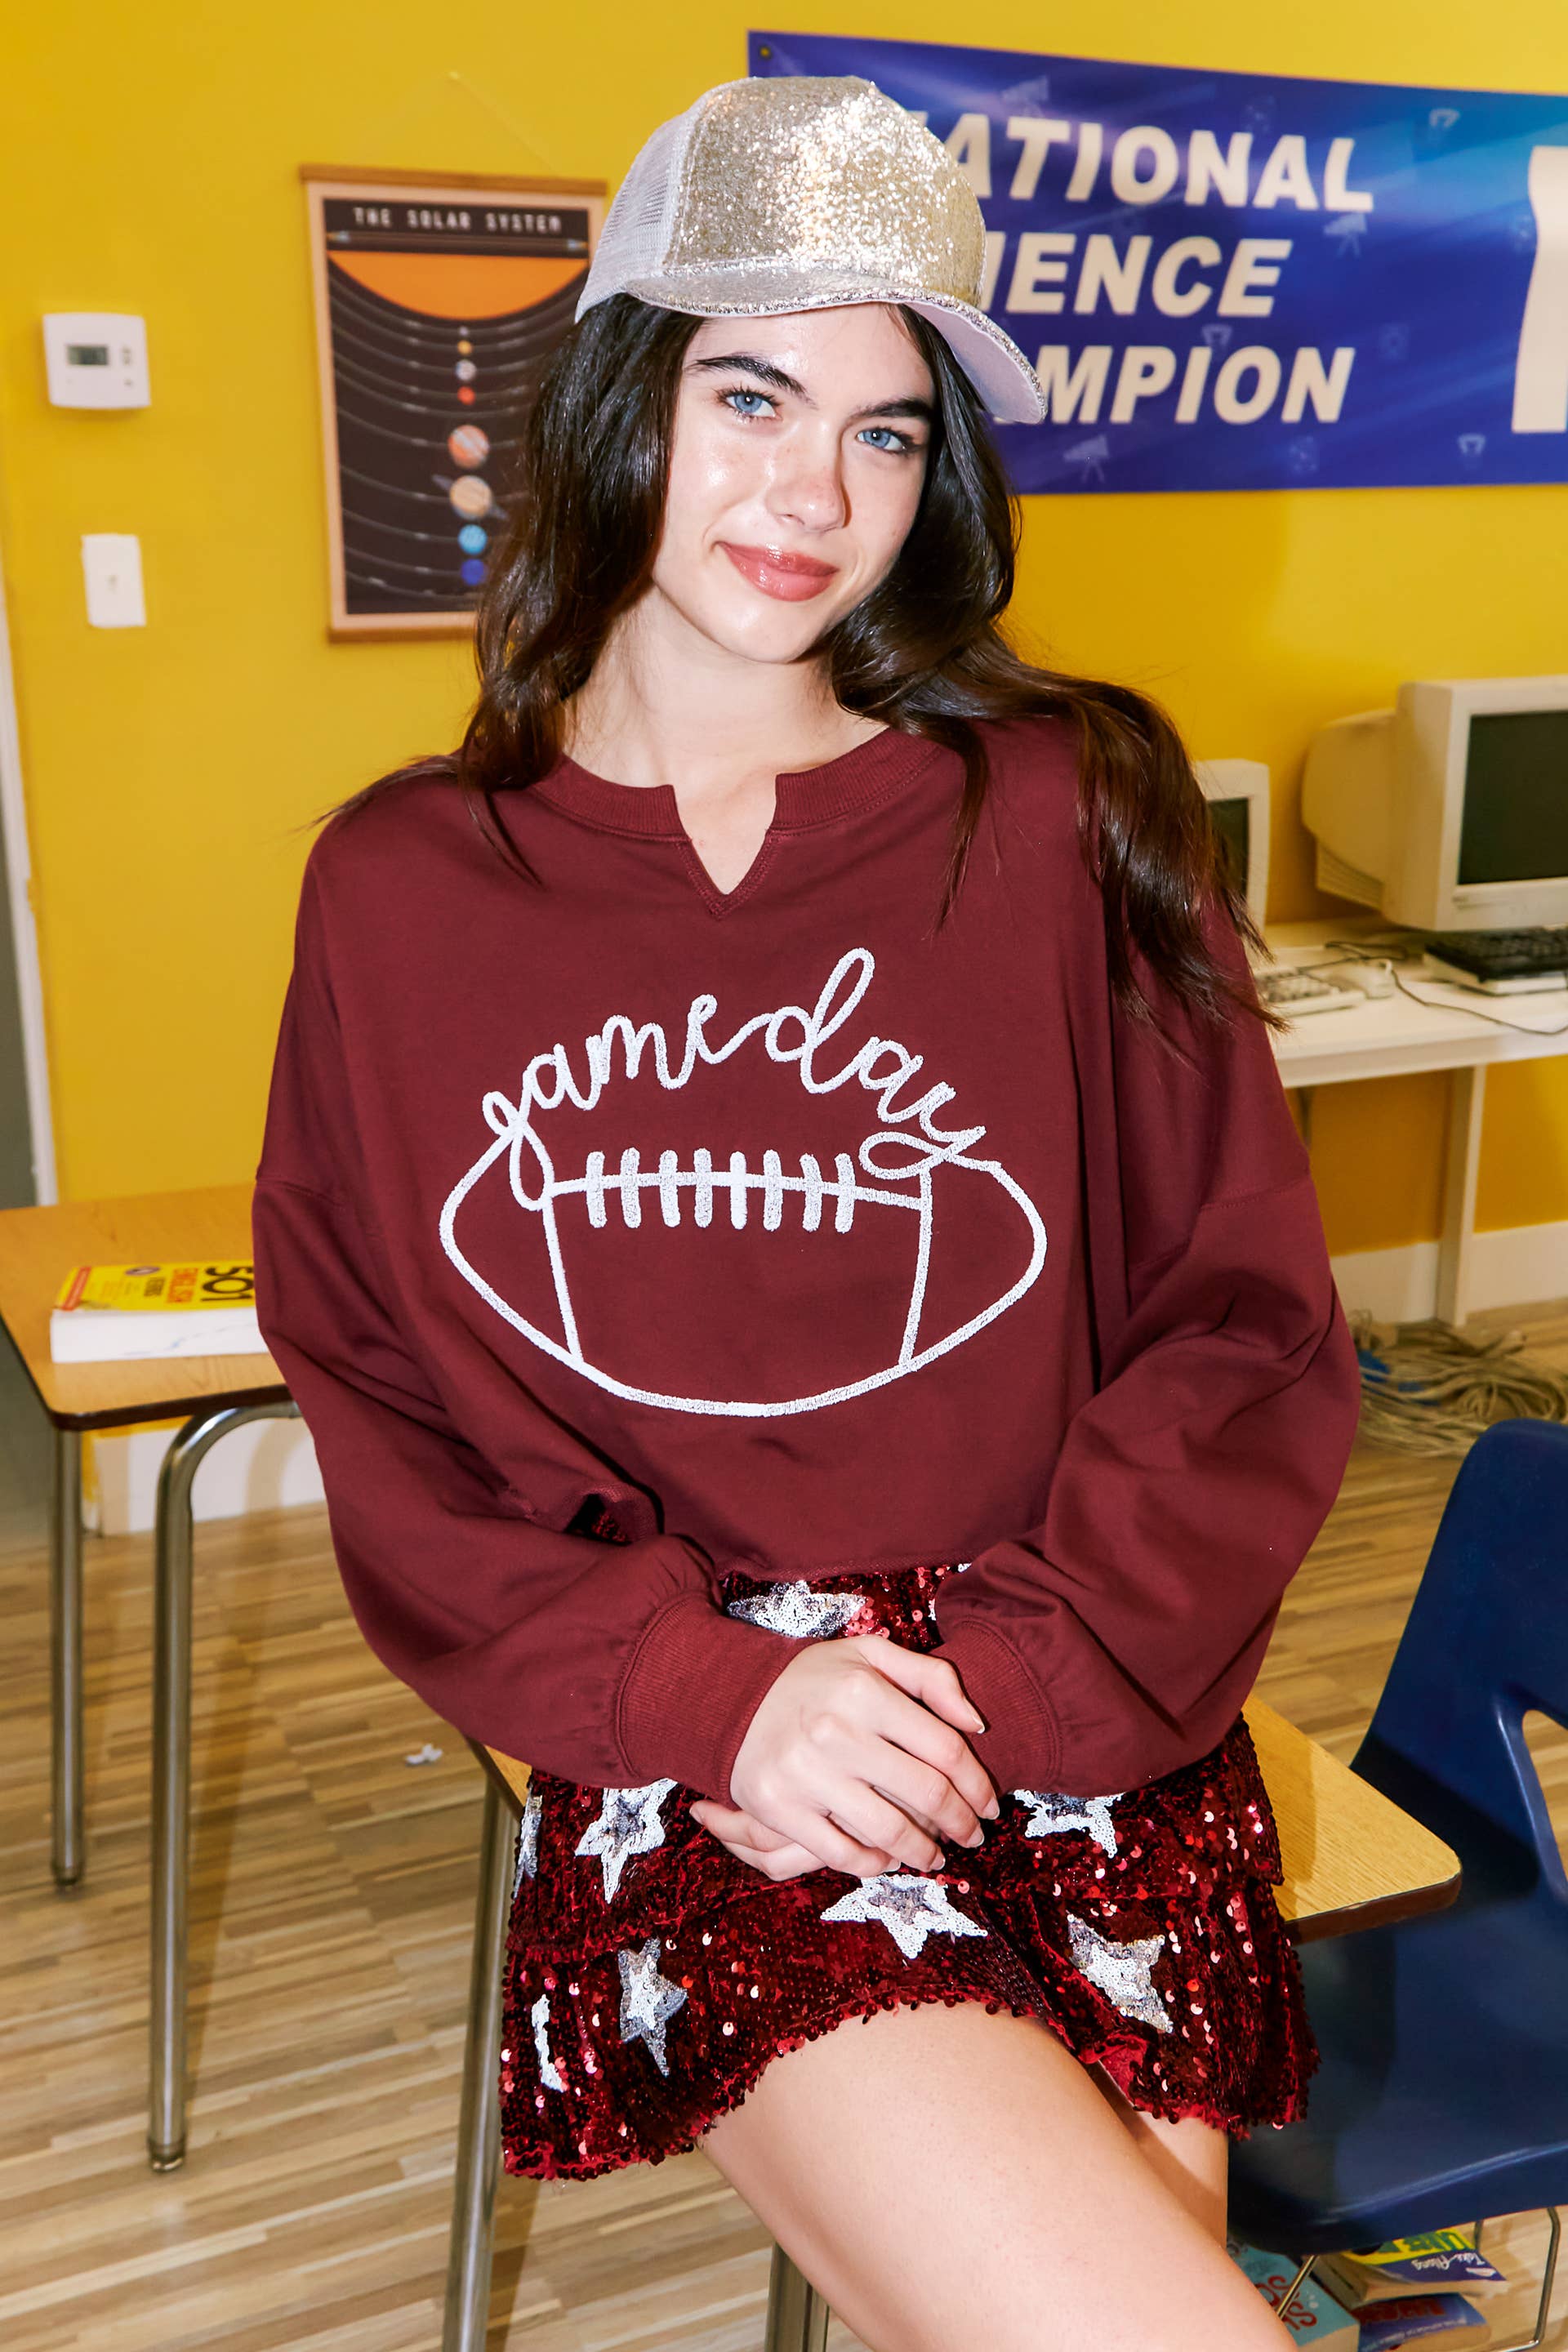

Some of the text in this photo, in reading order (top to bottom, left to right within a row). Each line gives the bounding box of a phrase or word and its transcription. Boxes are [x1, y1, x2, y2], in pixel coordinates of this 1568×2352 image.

[909, 112, 1374, 212] ATIONAL
[353, 207, 563, 233] THE SOLAR SYSTEM
[980, 231, 1293, 318] IENCE
[994, 345, 1355, 425] MPION
